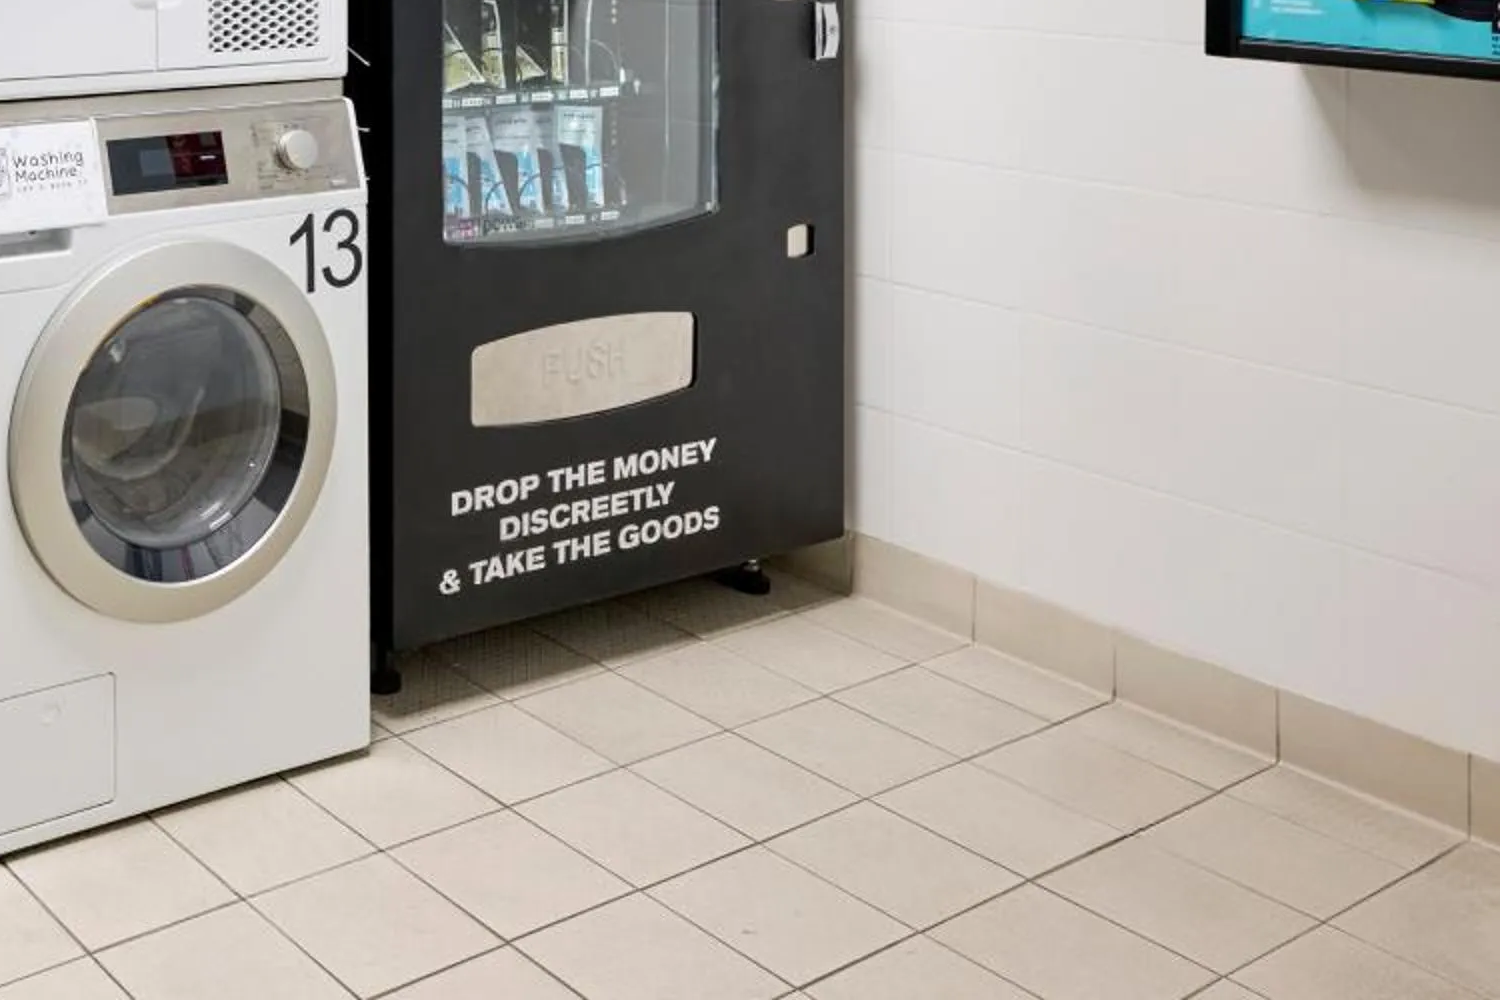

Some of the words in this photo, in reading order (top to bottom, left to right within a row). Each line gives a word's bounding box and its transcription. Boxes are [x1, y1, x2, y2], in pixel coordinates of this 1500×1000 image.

[12, 151, 85, 169] Washing
[15, 166, 77, 183] Machine
[289, 208, 363, 293] 13
[541, 340, 627, 389] PUSH
[451, 473, 540, 517] DROP
[547, 460, 606, 494] THE
[613, 437, 717, 480] MONEY
[499, 481, 675, 541] DISCREETLY
[439, 568, 462, 596] &
[469, 545, 546, 585] TAKE
[553, 531, 612, 566] THE
[617, 506, 721, 550] GOODS
